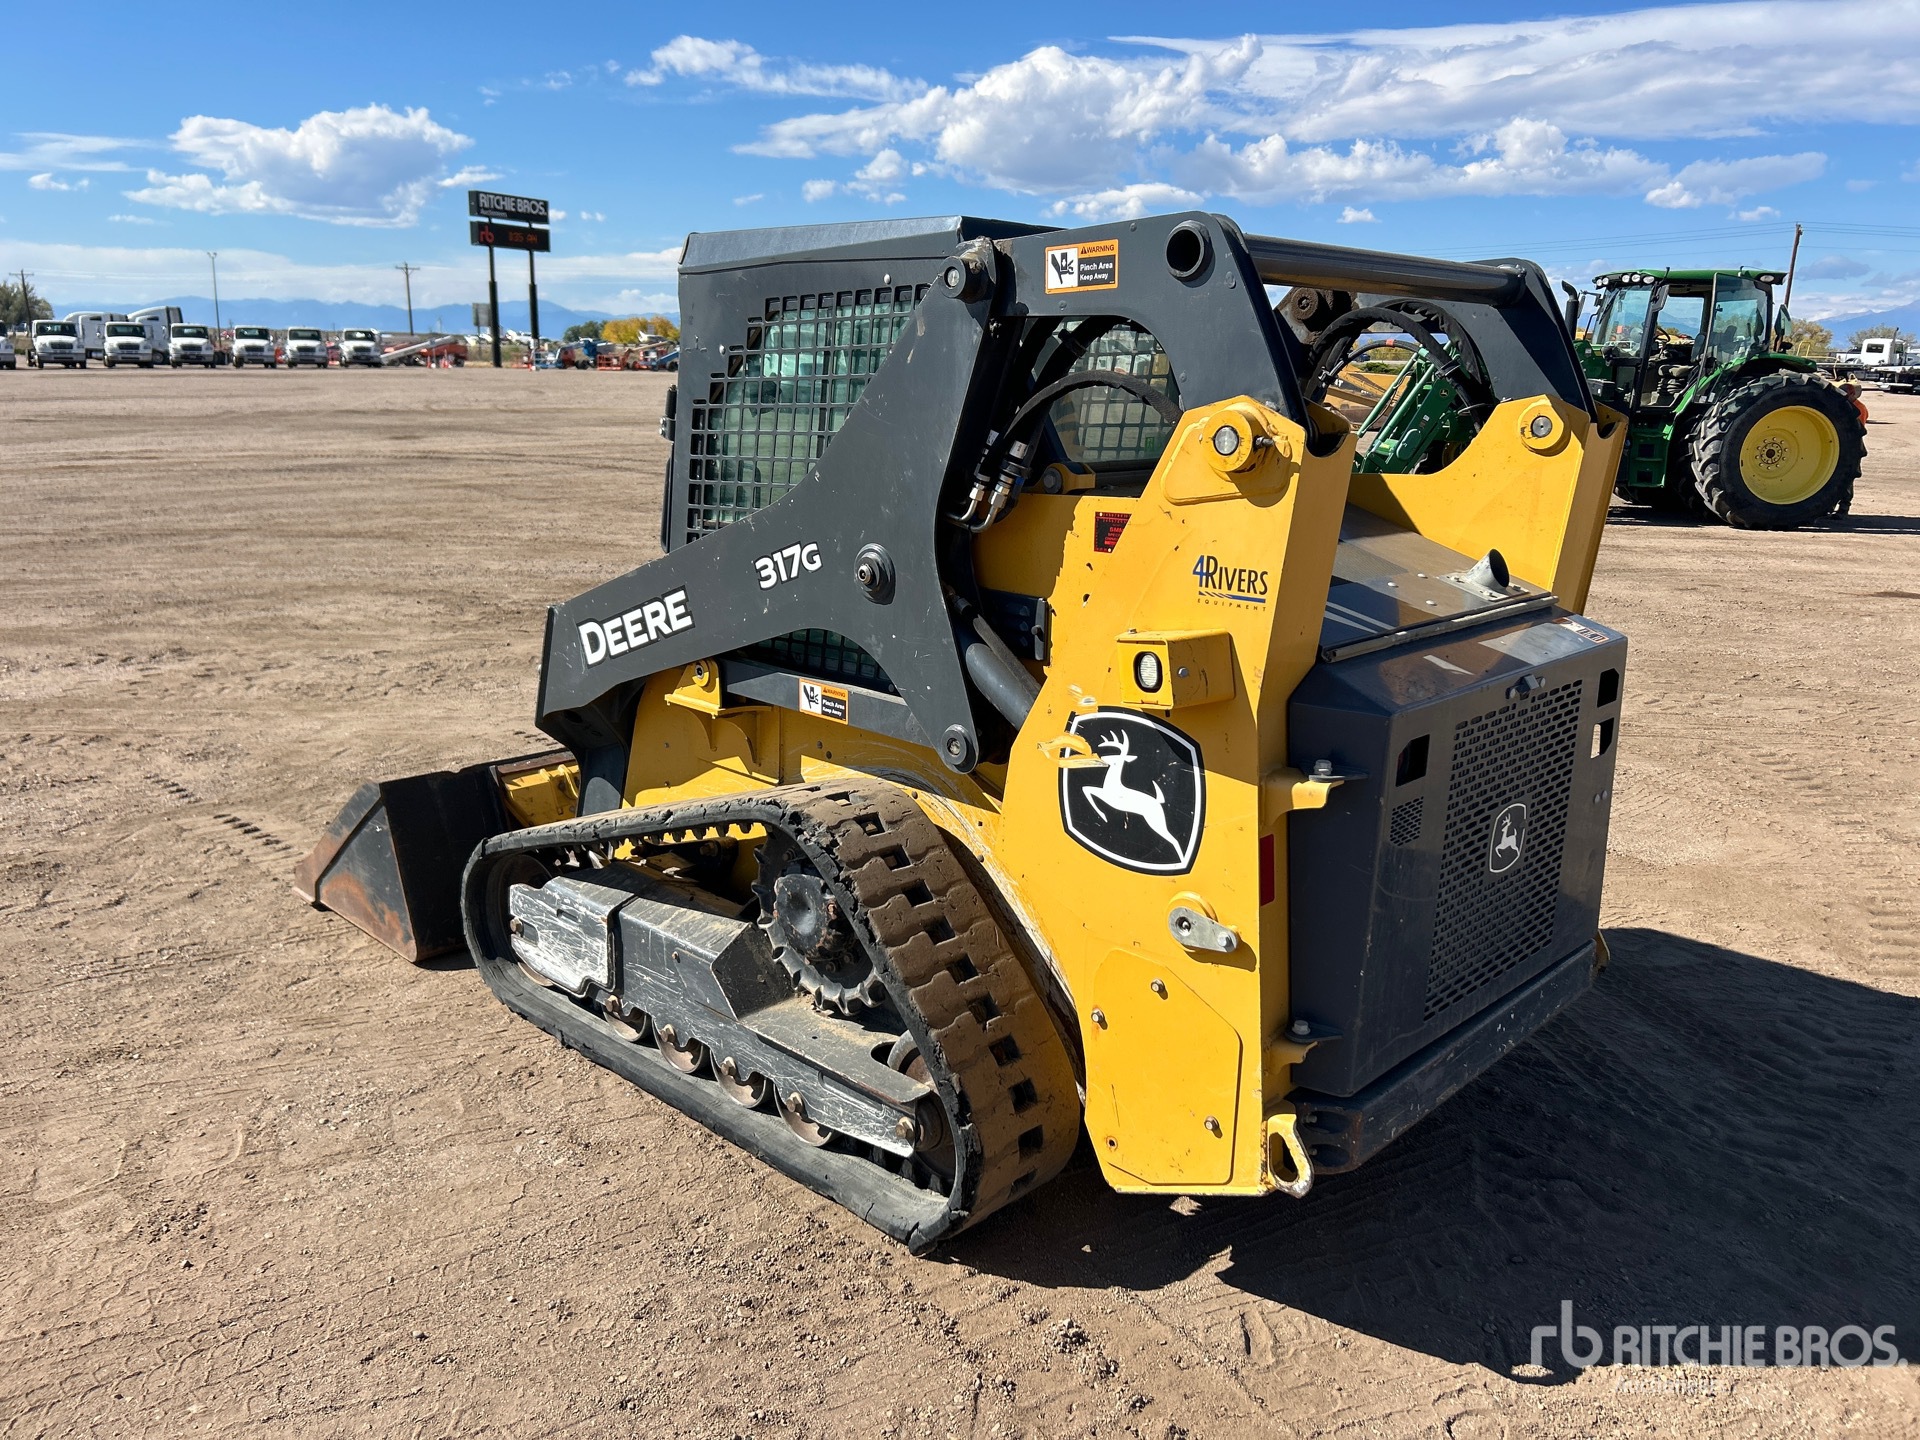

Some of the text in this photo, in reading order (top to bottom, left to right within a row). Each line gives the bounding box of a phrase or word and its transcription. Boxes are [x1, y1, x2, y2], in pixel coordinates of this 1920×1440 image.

[479, 193, 516, 212] RITCHIE
[1086, 244, 1115, 253] WARNING
[1080, 261, 1113, 271] Pinch Area
[1080, 272, 1108, 281] Keep Away
[754, 543, 822, 589] 317G
[1197, 598, 1267, 612] EQUIPMENT
[578, 589, 693, 666] DEERE
